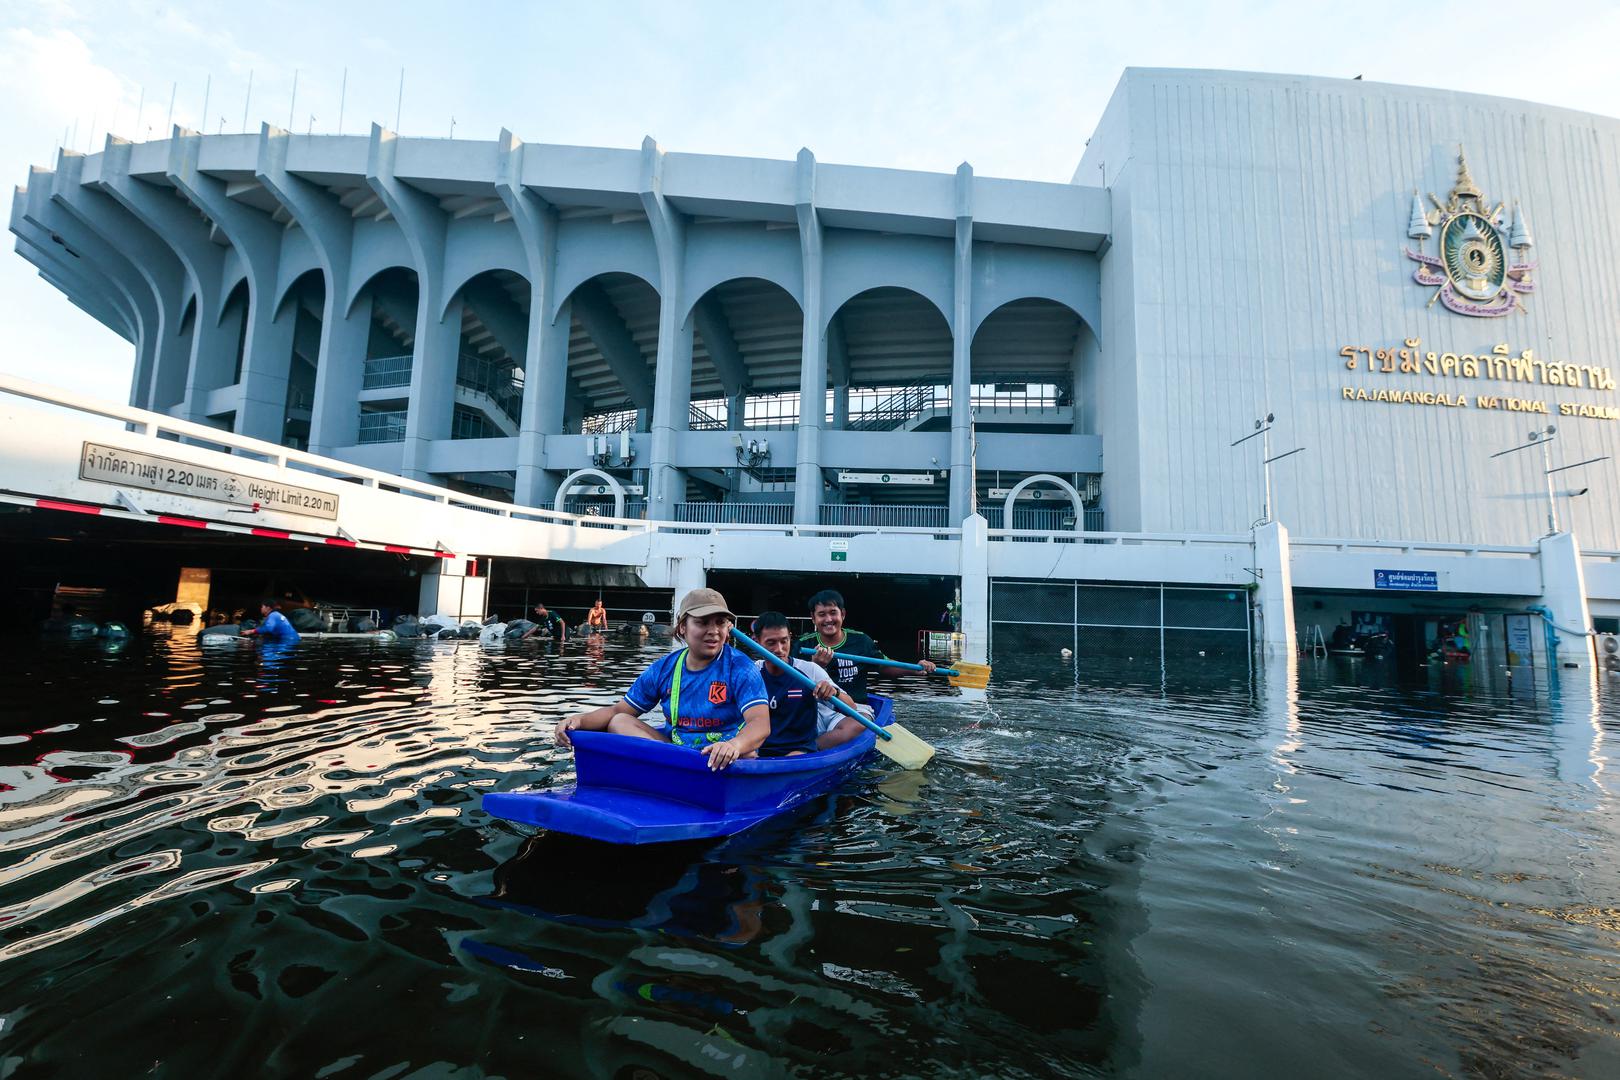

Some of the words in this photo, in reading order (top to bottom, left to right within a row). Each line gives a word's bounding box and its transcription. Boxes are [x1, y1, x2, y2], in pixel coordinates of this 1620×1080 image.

[1340, 337, 1616, 390] ราชมังคลากีฬาสถาน
[1342, 387, 1468, 407] RAJAMANGALA
[1477, 395, 1551, 414] NATIONAL
[88, 449, 163, 484] จำกัดความสูง
[167, 468, 194, 487] 2.20
[196, 475, 218, 491] เมตร
[248, 485, 278, 505] (Height
[281, 488, 302, 506] Limit
[303, 496, 322, 509] 2.20
[837, 658, 853, 667] WIN
[838, 666, 858, 678] YOUR
[770, 695, 777, 709] 6
